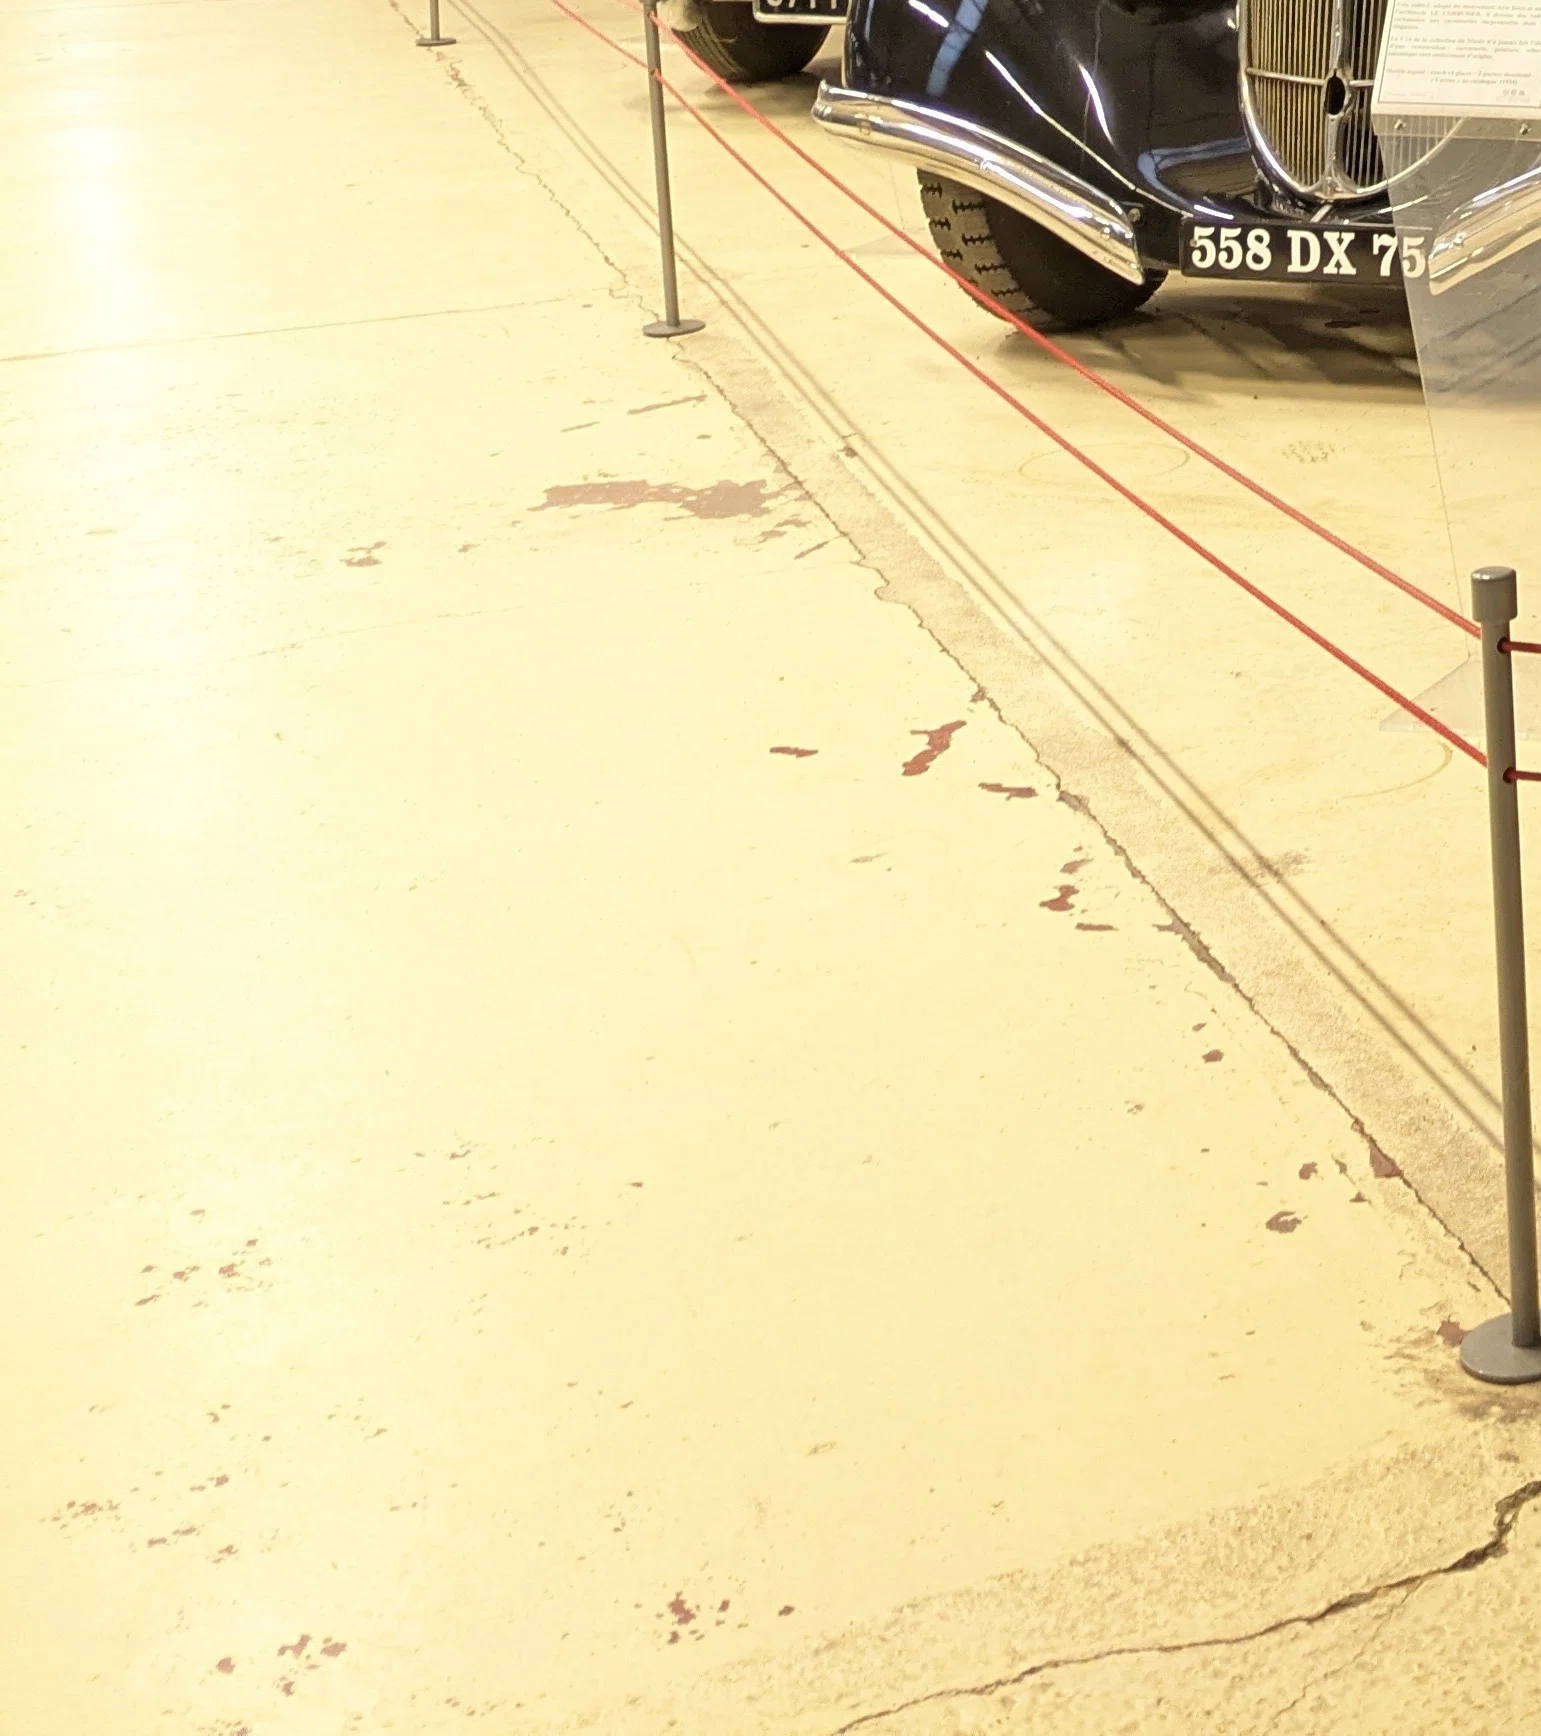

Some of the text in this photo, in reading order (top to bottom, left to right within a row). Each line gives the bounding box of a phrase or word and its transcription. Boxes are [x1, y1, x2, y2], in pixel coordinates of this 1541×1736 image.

[1190, 225, 1427, 279] 558 DX 75
